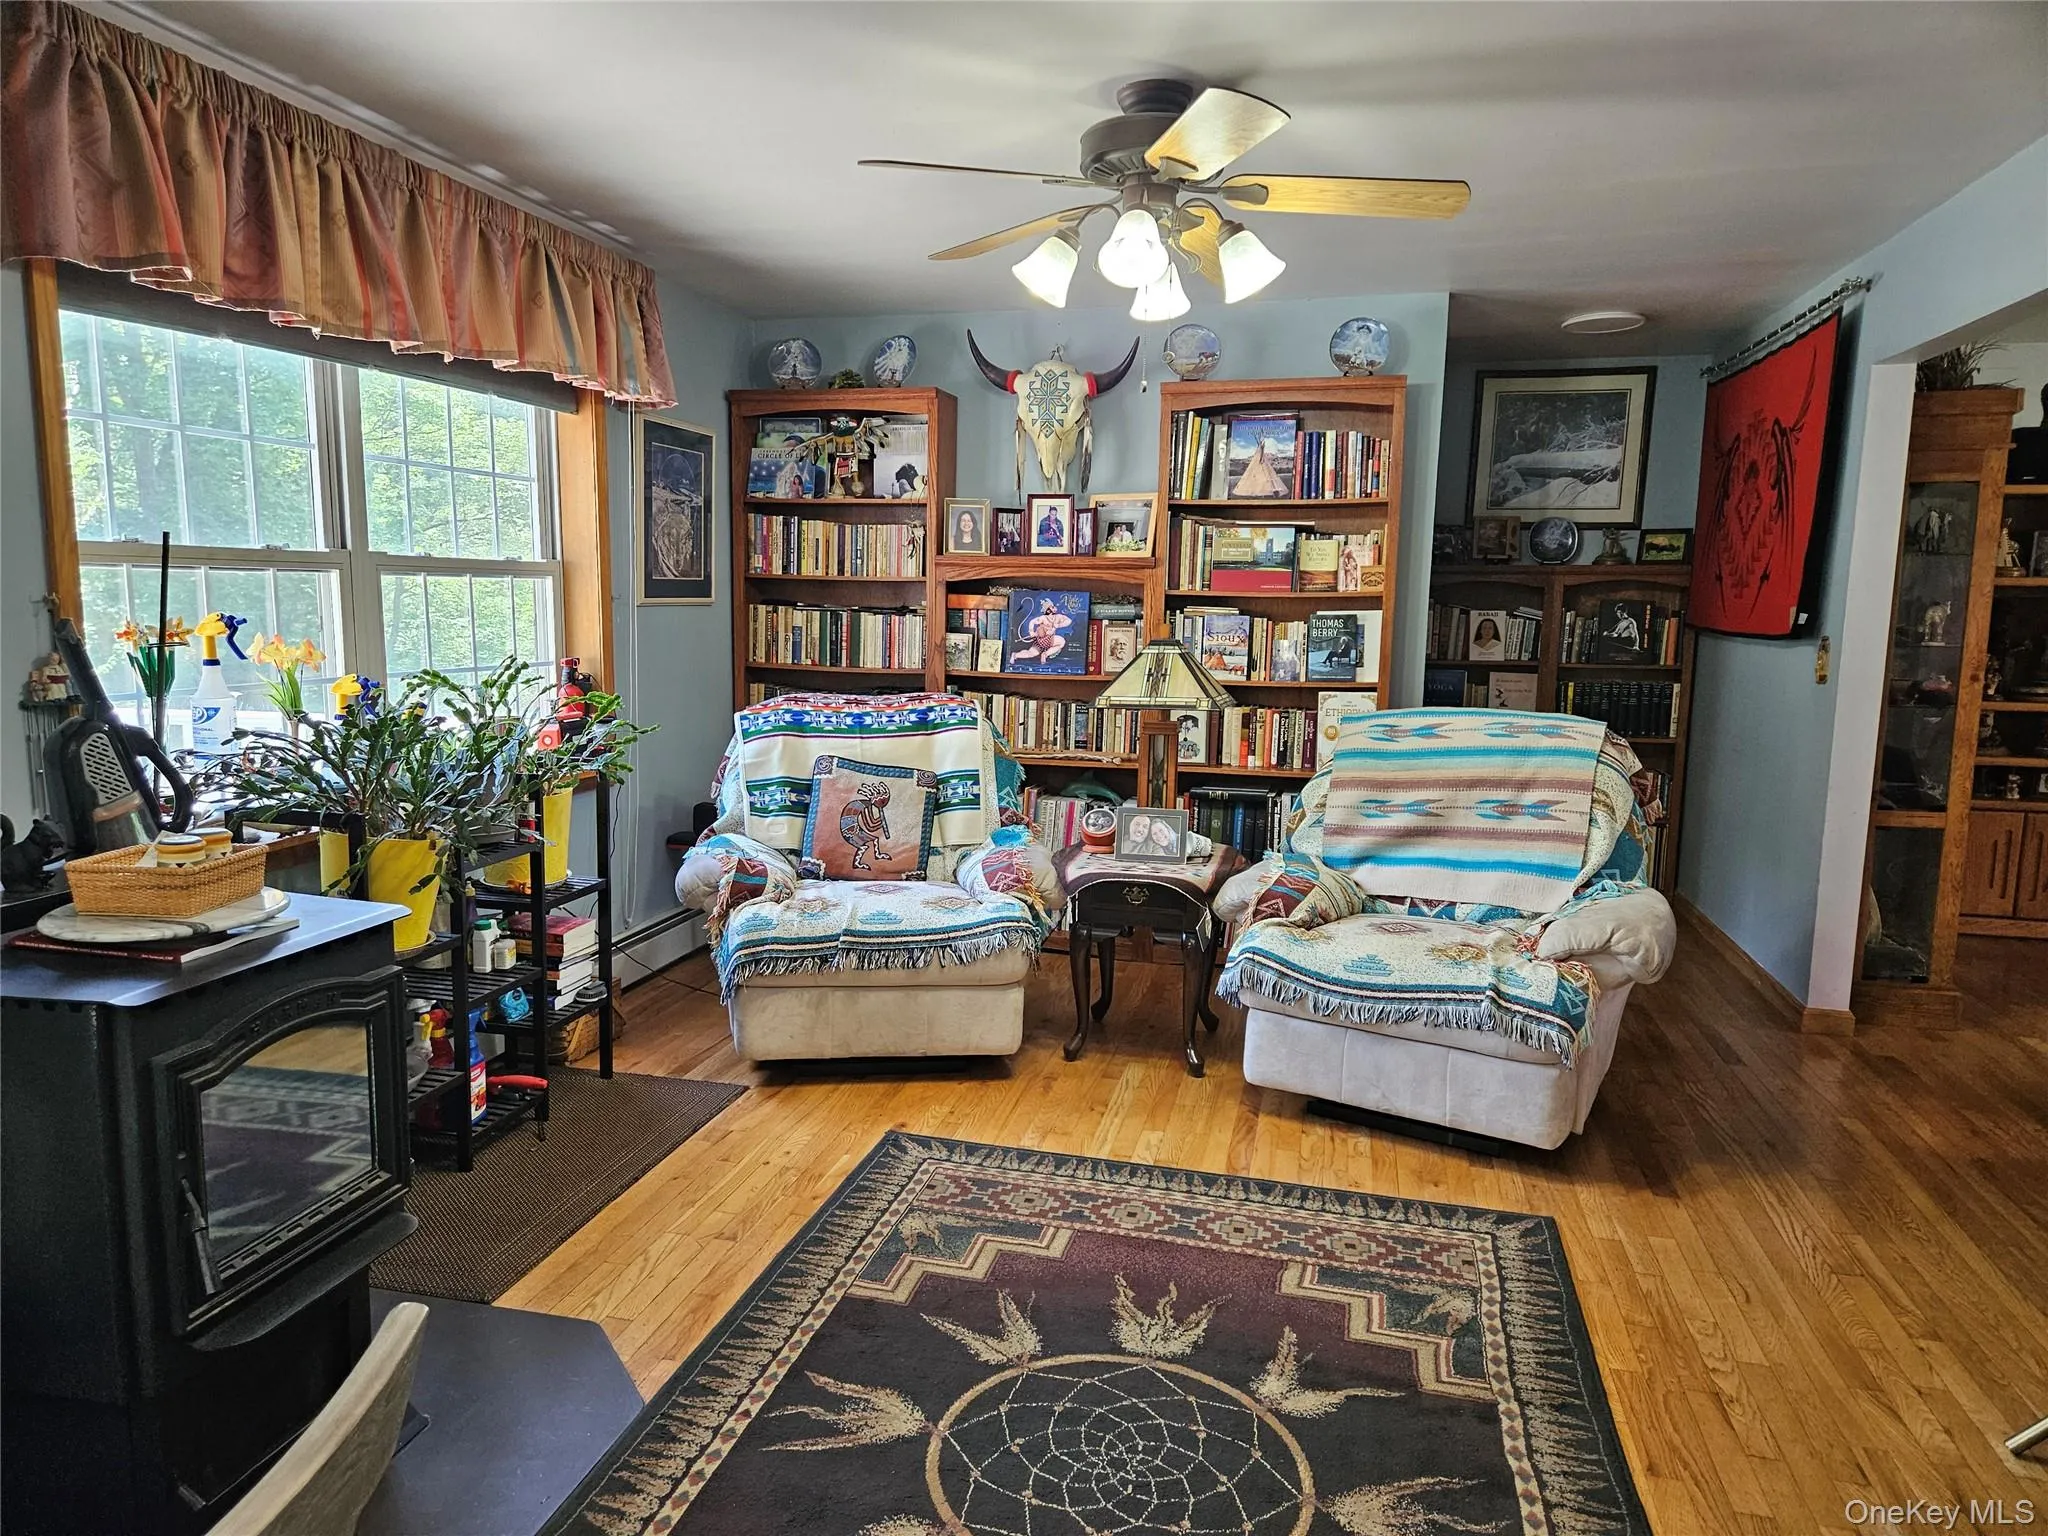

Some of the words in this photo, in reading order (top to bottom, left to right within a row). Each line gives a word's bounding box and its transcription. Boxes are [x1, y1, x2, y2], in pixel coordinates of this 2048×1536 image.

[1312, 619, 1344, 628] THOMAS
[1312, 629, 1338, 637] BERRY
[1428, 683, 1453, 691] YOGA
